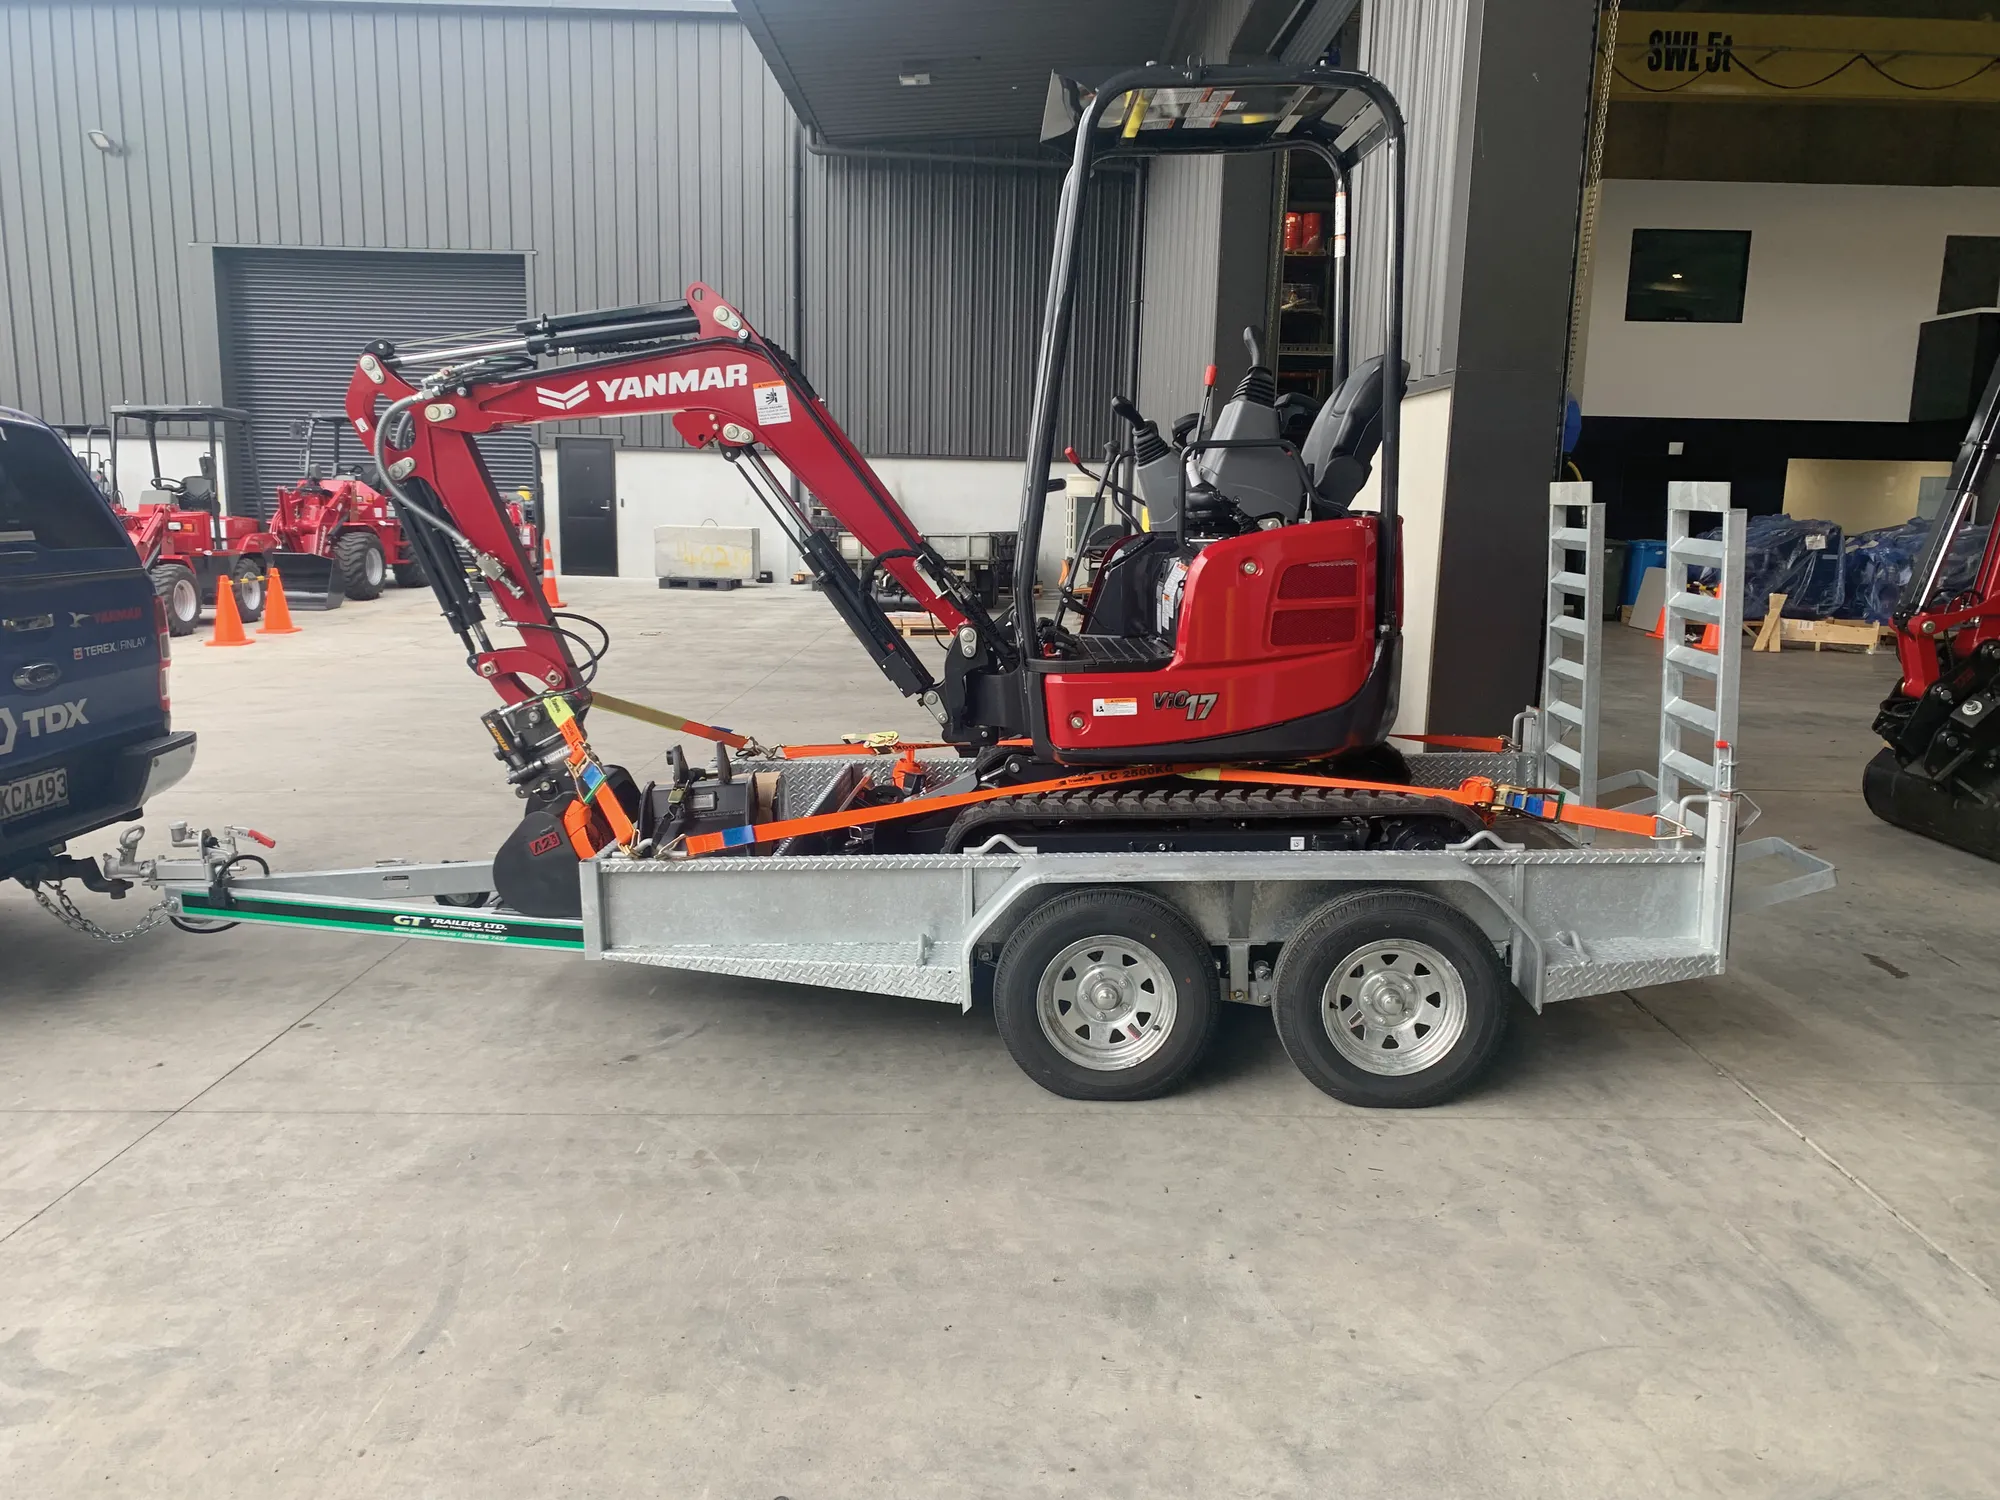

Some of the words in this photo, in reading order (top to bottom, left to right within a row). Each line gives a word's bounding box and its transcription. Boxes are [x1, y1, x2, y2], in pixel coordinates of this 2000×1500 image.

[1647, 29, 1699, 72] SWL
[596, 363, 748, 403] YANMAR
[83, 642, 117, 657] TEREX
[120, 636, 147, 651] FINLAY
[22, 698, 90, 738] TDX
[1100, 771, 1118, 782] LC
[1122, 763, 1175, 779] 2500KG
[0, 773, 67, 817] KCA493
[393, 915, 426, 927] GT
[429, 917, 482, 928] TRAILERS
[484, 922, 508, 931] LTD.
